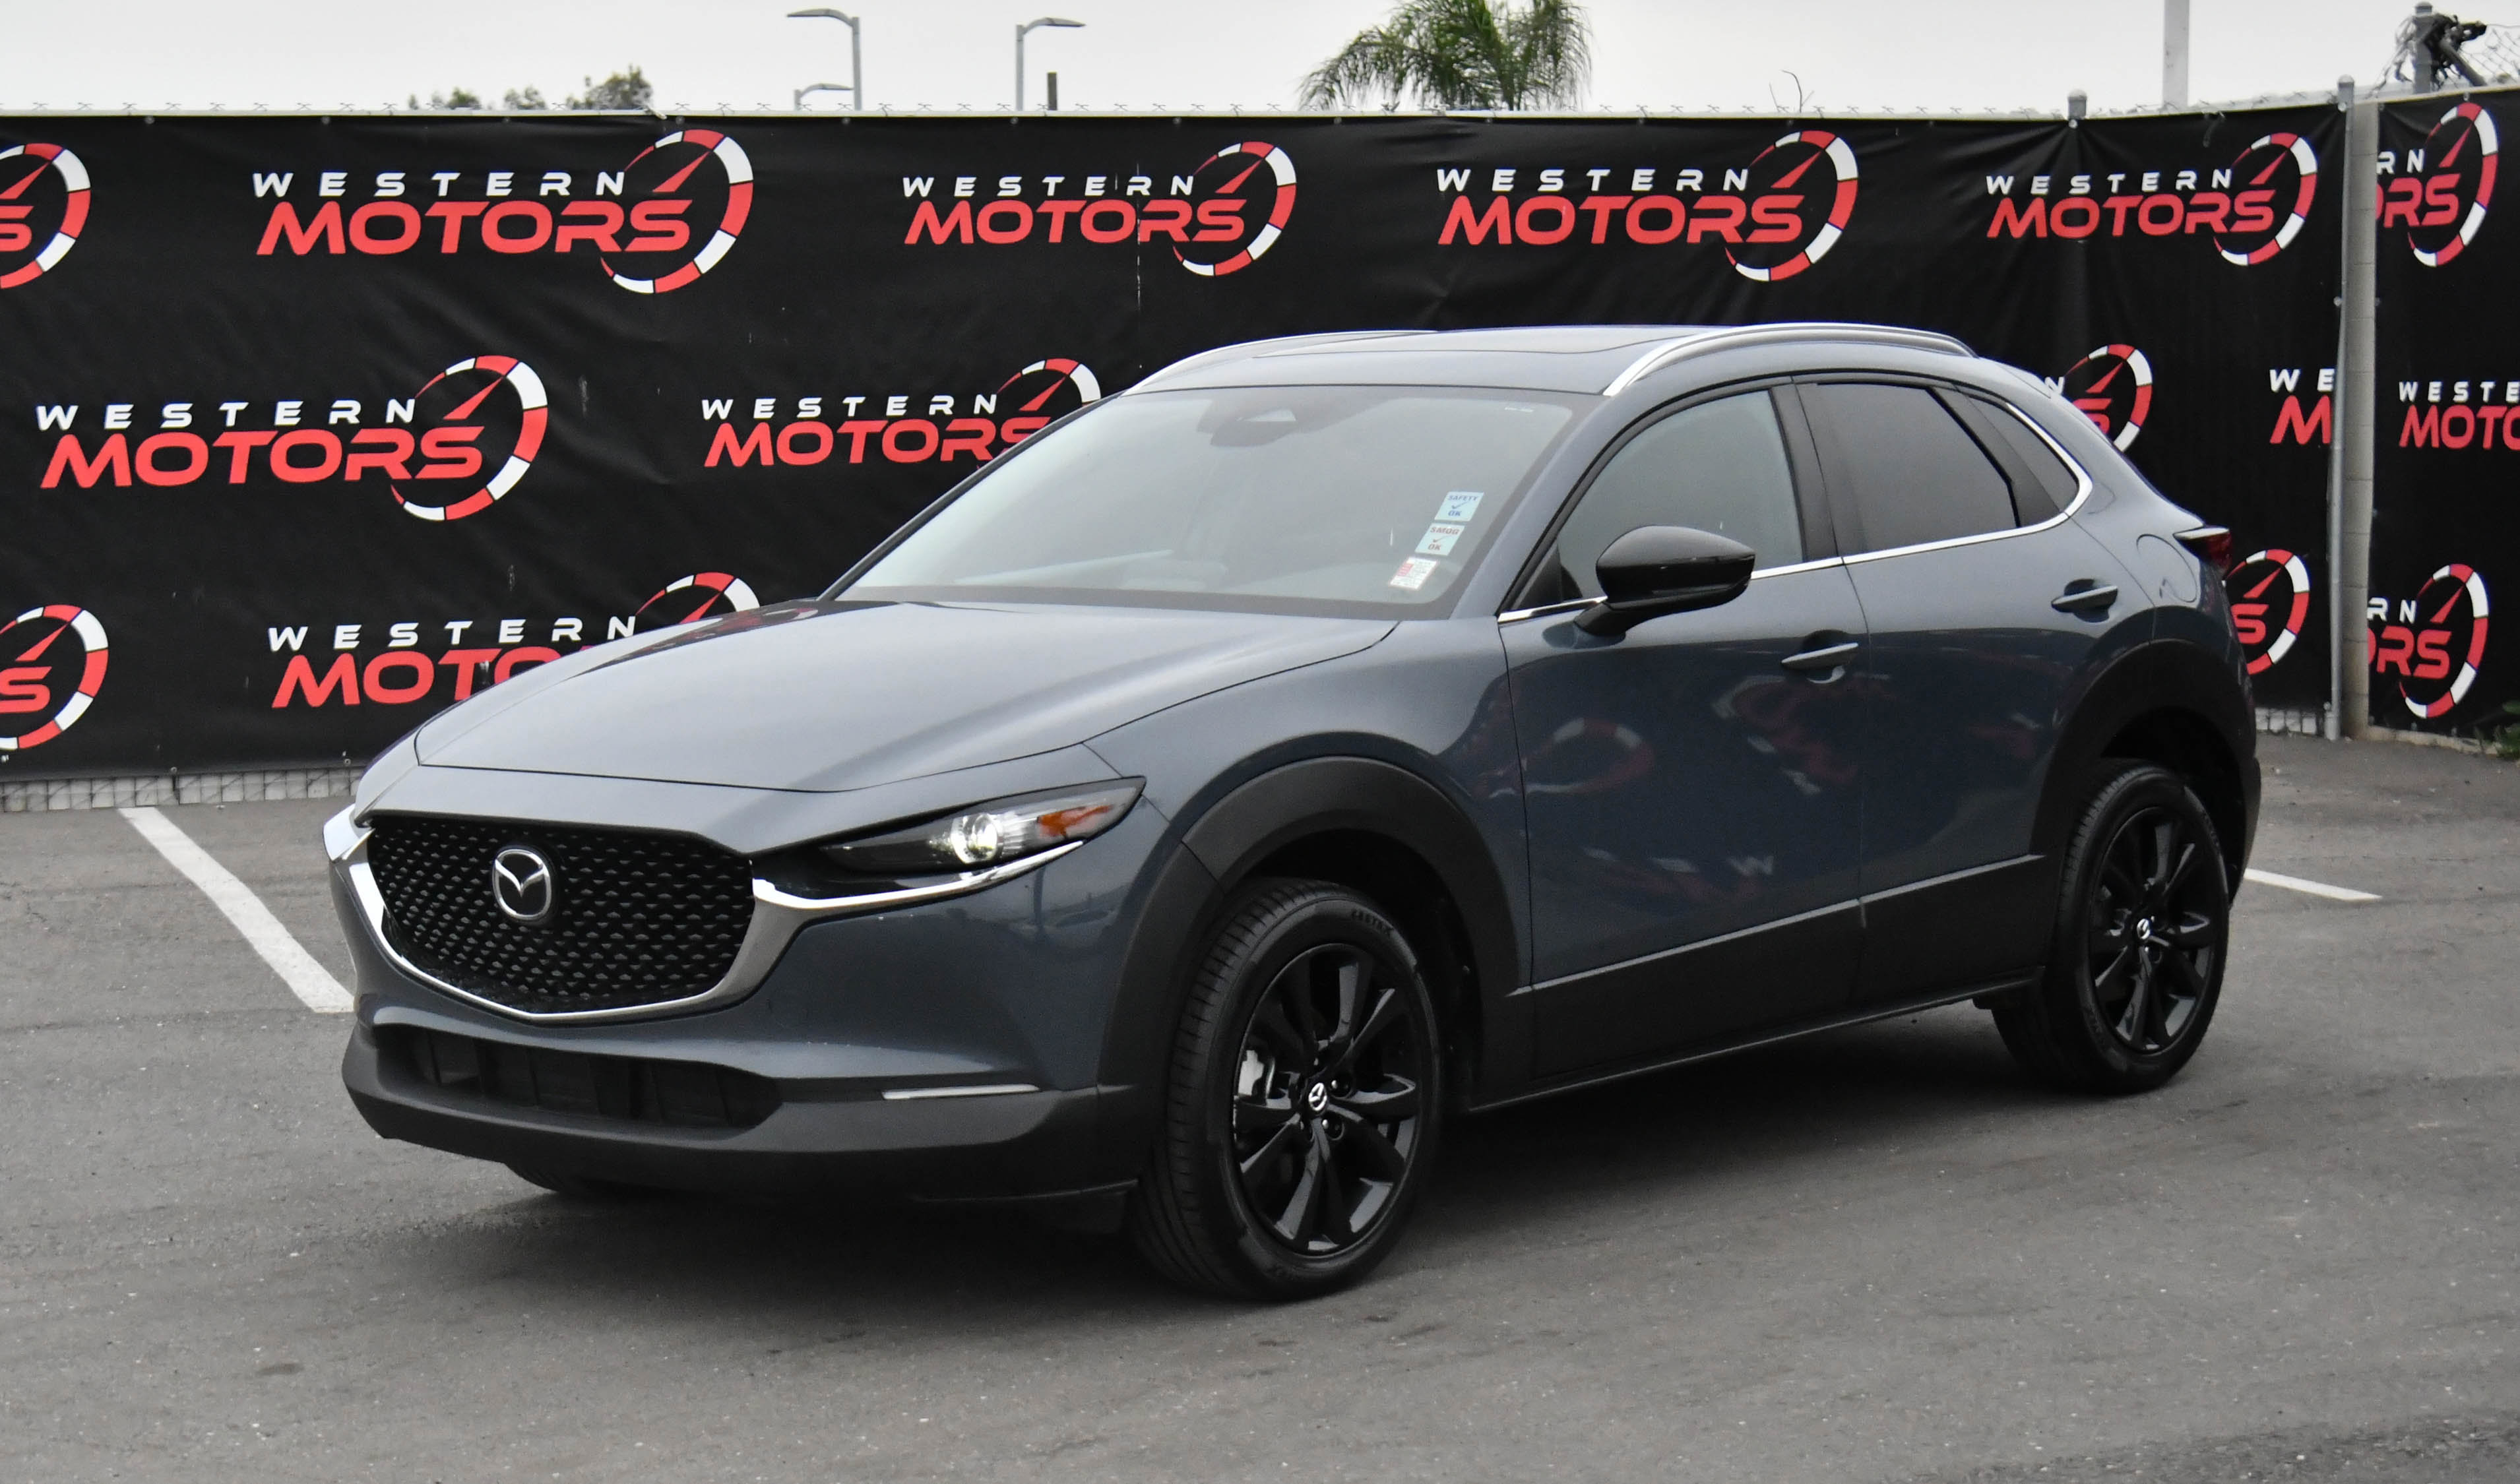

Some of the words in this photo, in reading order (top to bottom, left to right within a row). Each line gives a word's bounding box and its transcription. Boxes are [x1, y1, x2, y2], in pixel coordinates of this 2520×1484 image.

[253, 172, 624, 197] WESTERN
[903, 176, 1193, 197] WESTERN
[1437, 170, 1748, 191] WESTERN
[1986, 169, 2232, 194] WESTERN
[257, 200, 691, 255] MOTORS
[904, 199, 1246, 245] MOTORS
[1439, 195, 1804, 245] MOTORS
[1987, 190, 2275, 238] MOTORS
[702, 394, 997, 419] WESTERN
[2399, 381, 2520, 402] WESTE
[37, 399, 415, 430] WESTERN
[41, 426, 484, 488] MOTORS
[268, 616, 636, 651] WESTERN
